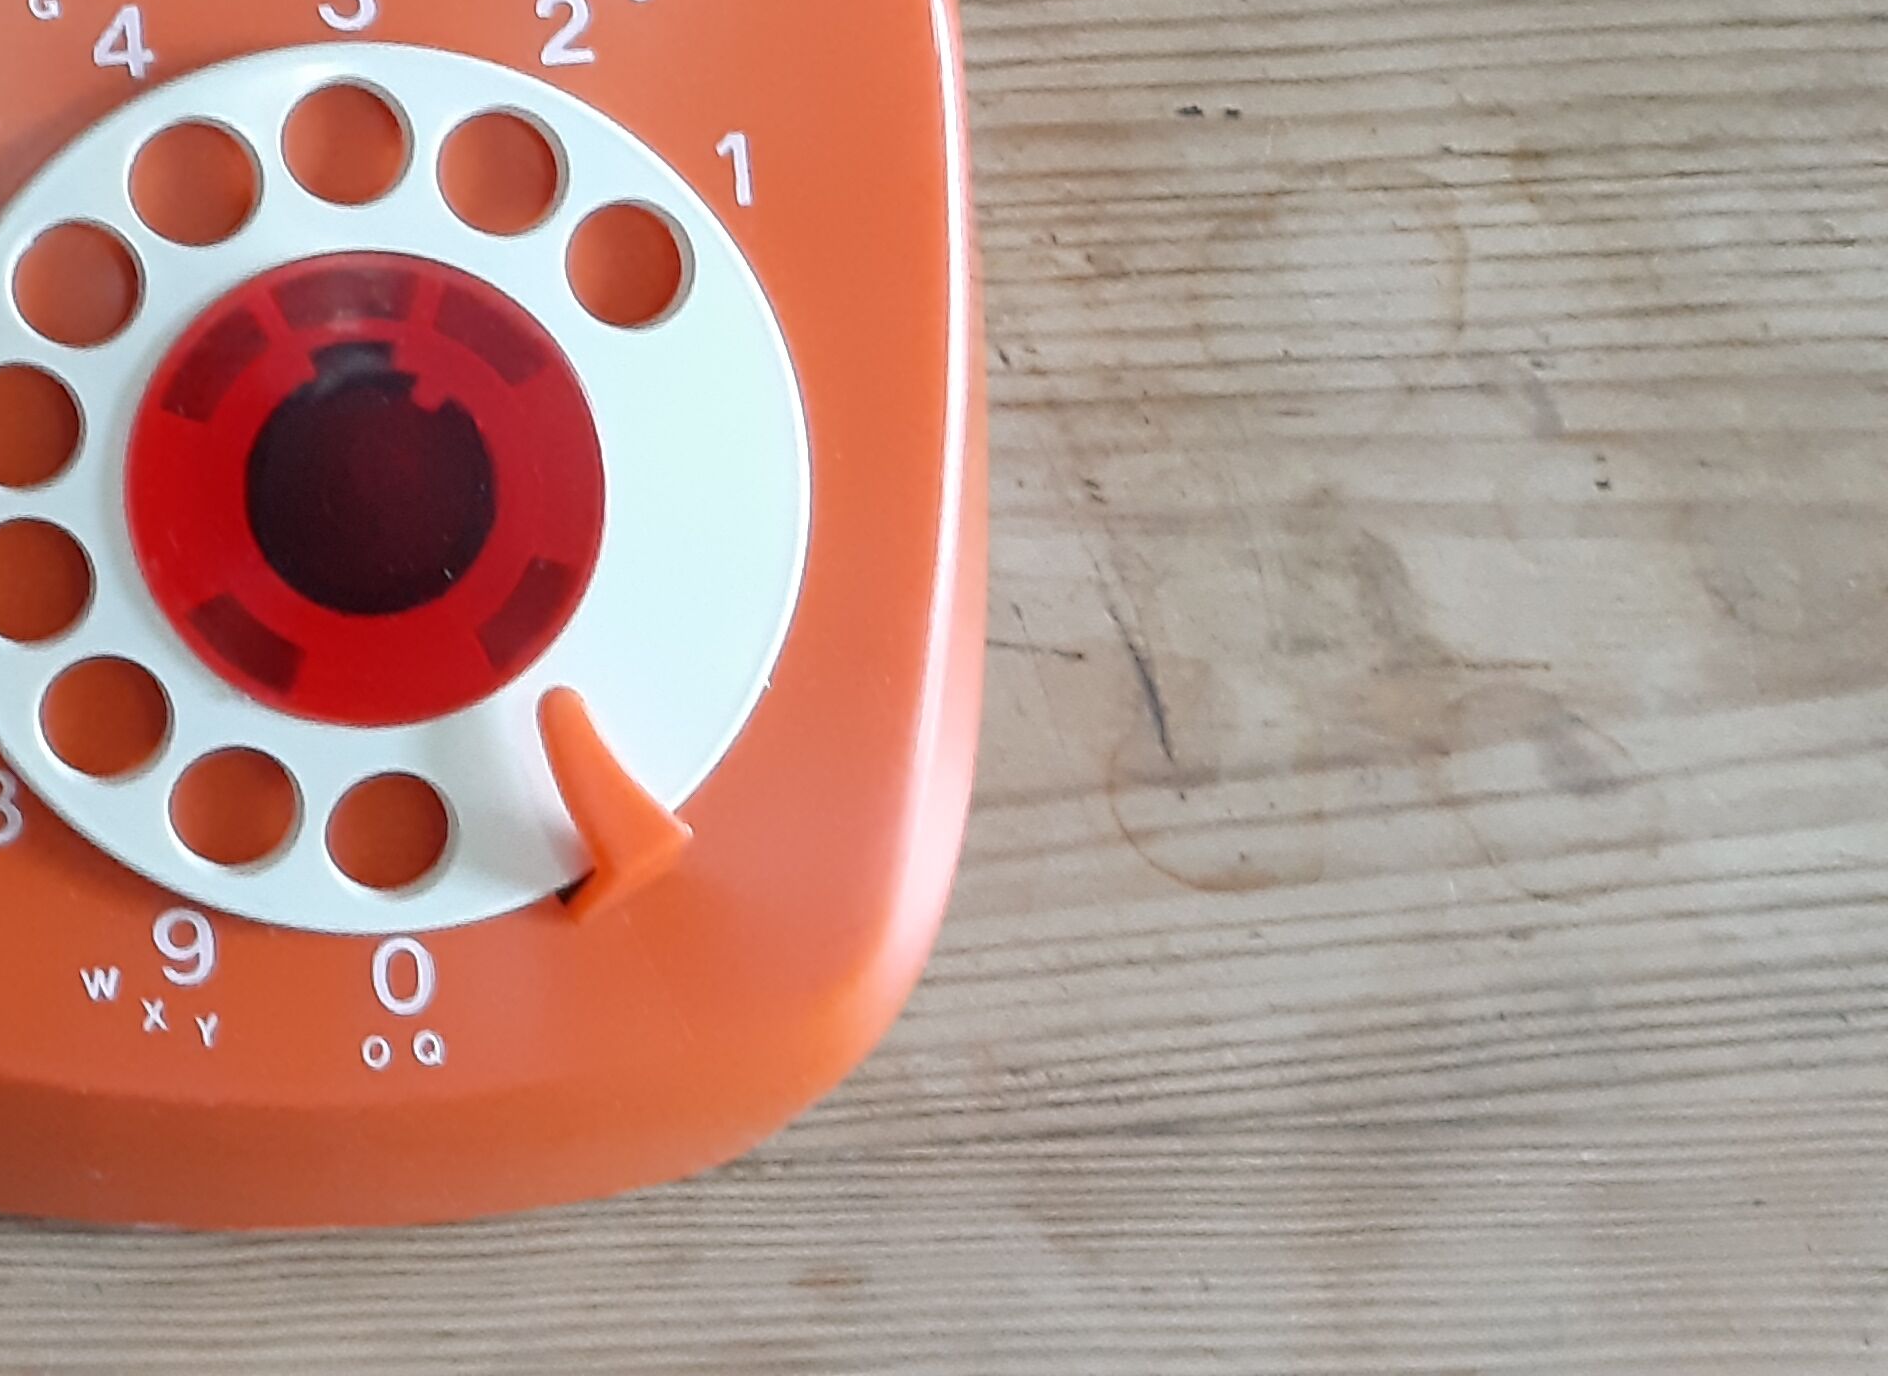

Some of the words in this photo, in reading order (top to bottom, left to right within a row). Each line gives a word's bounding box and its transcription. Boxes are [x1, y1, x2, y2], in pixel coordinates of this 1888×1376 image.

[93, 4, 156, 78] 4
[715, 131, 754, 207] 1
[152, 908, 216, 986] 9
[372, 935, 437, 1016] 0
